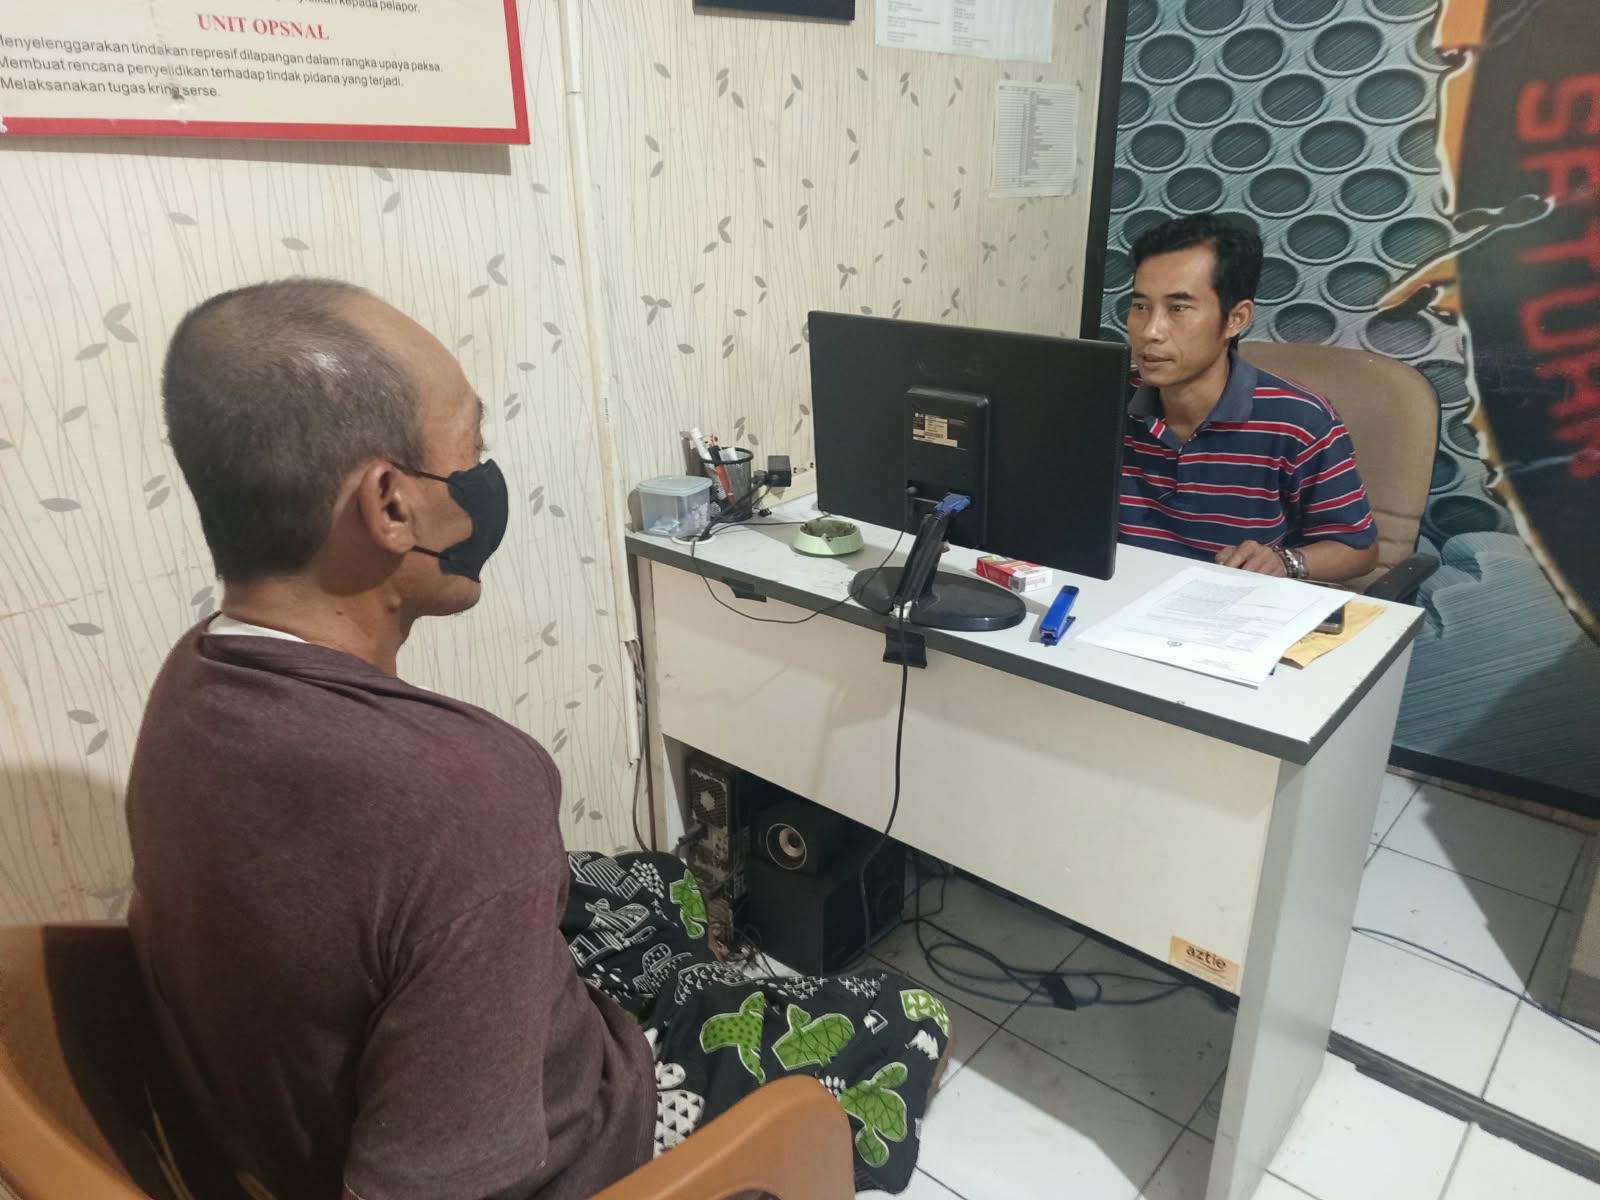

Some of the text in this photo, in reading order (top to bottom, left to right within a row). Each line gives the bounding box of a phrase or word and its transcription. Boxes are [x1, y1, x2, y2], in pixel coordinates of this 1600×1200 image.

[380, 0, 421, 14] pelapor.
[195, 12, 330, 41] UNIT OPSNAL
[131, 42, 188, 57] tindakan
[190, 48, 238, 61] represif
[239, 49, 304, 66] dilapangan
[305, 53, 340, 66] dalam
[341, 56, 378, 70] rangka
[379, 59, 410, 72] upaya
[411, 60, 444, 73] paksa.
[0, 56, 404, 89] Membuat rencana penyelidikan terhadap tindak pidana yang terjadi.
[0, 76, 221, 98] Melaksanakan tugas kring serse.
